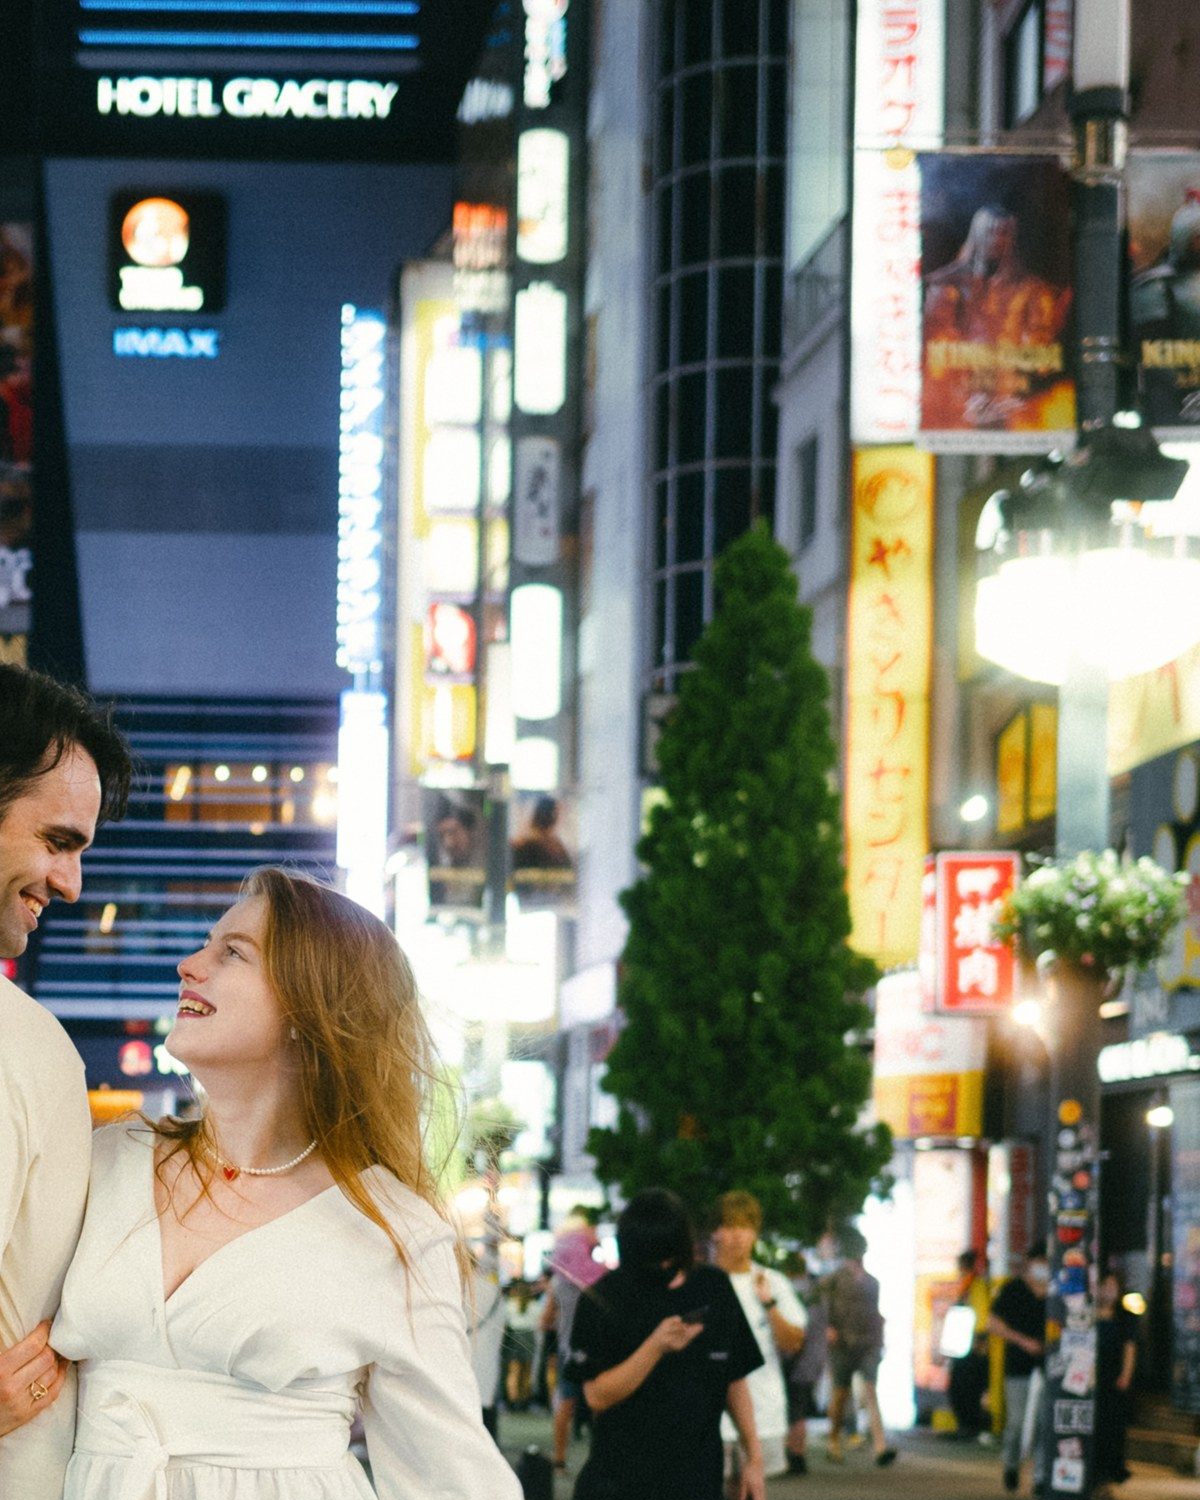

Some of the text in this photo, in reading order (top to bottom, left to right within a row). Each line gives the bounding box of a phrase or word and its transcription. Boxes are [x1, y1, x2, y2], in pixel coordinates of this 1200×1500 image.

[97, 77, 399, 119] HOTEL GRACERY
[113, 327, 219, 358] IMAX
